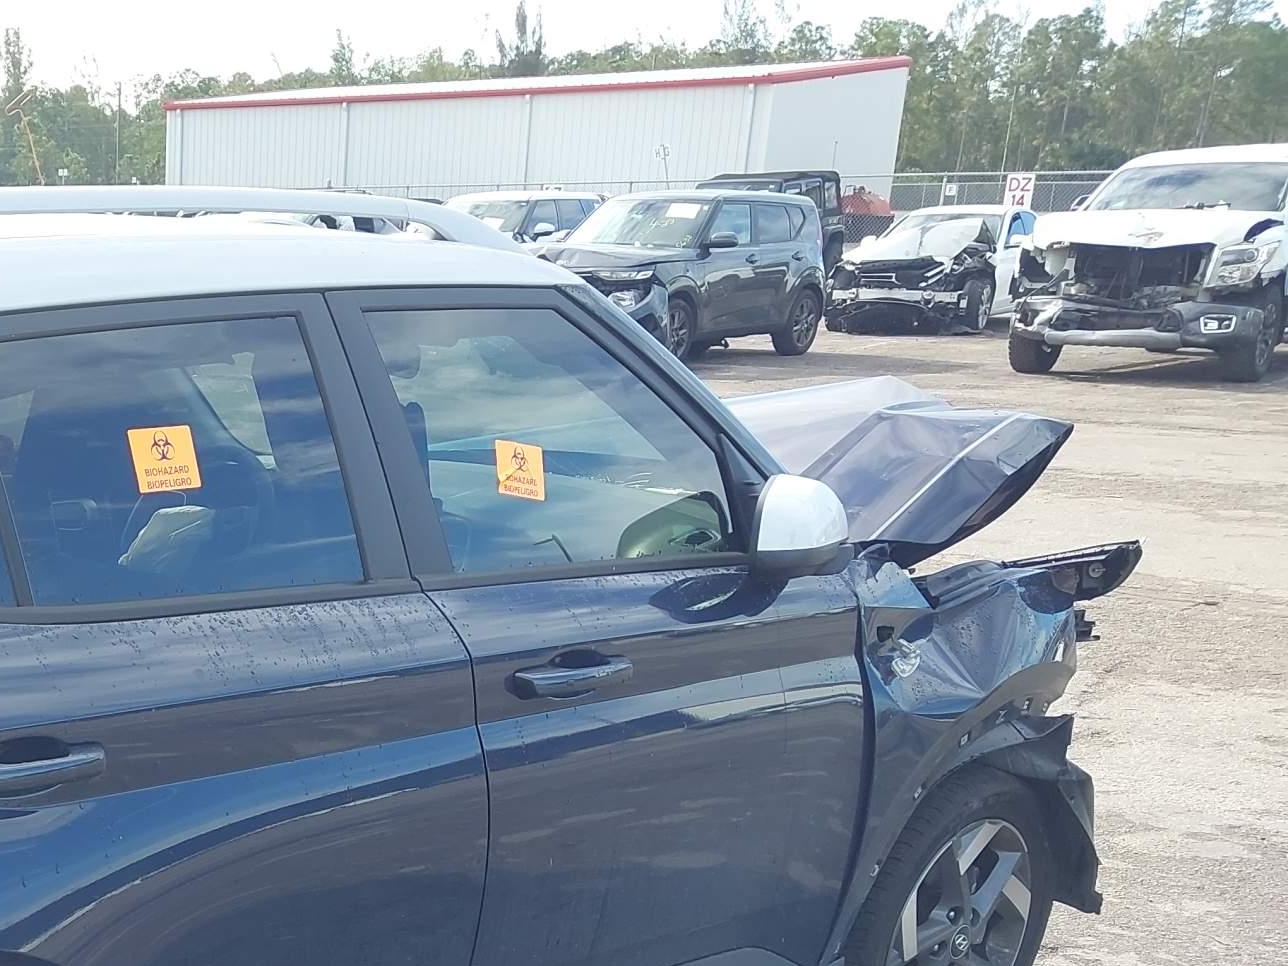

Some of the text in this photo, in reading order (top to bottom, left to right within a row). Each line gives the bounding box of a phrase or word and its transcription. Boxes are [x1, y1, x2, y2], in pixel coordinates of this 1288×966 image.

[1008, 177, 1033, 192] DZ
[1011, 194, 1025, 207] 14
[144, 464, 190, 477] BIOHAZARD
[147, 477, 192, 490] BIOPELIGRO
